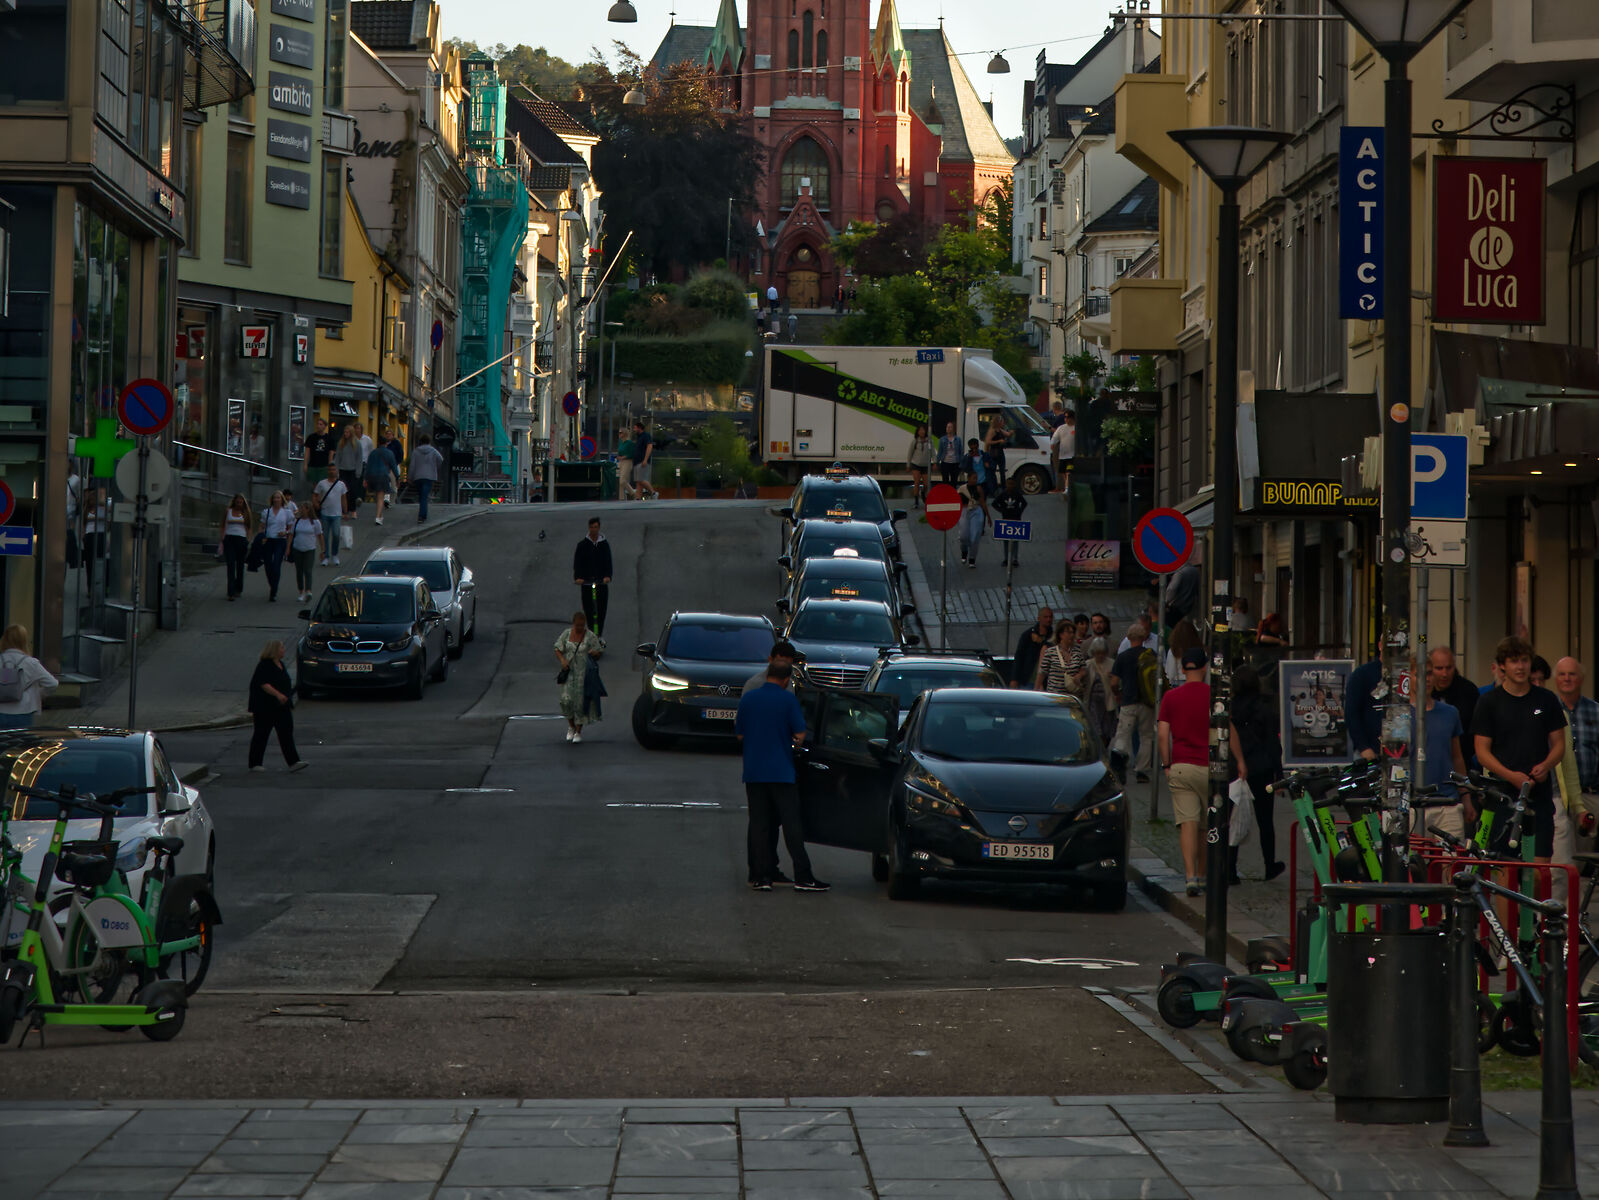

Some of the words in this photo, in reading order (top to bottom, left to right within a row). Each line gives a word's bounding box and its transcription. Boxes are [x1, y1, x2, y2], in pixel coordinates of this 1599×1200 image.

[273, 83, 311, 109] ambita
[1468, 172, 1516, 222] Deli
[1356, 137, 1379, 285] ACTIC
[1478, 226, 1504, 269] de
[1463, 257, 1518, 308] Luca
[920, 351, 941, 361] Taxi
[858, 390, 887, 408] ABC
[840, 444, 885, 452] abckontor.no
[1410, 445, 1447, 507] P
[999, 522, 1026, 536] Taxi
[1071, 542, 1113, 562] Lille
[1301, 669, 1336, 680] ACTIC
[993, 845, 1008, 856] ED
[1014, 845, 1050, 858] 95518
[110, 921, 130, 931] OBOS
[1483, 909, 1522, 965] DIAMANT
